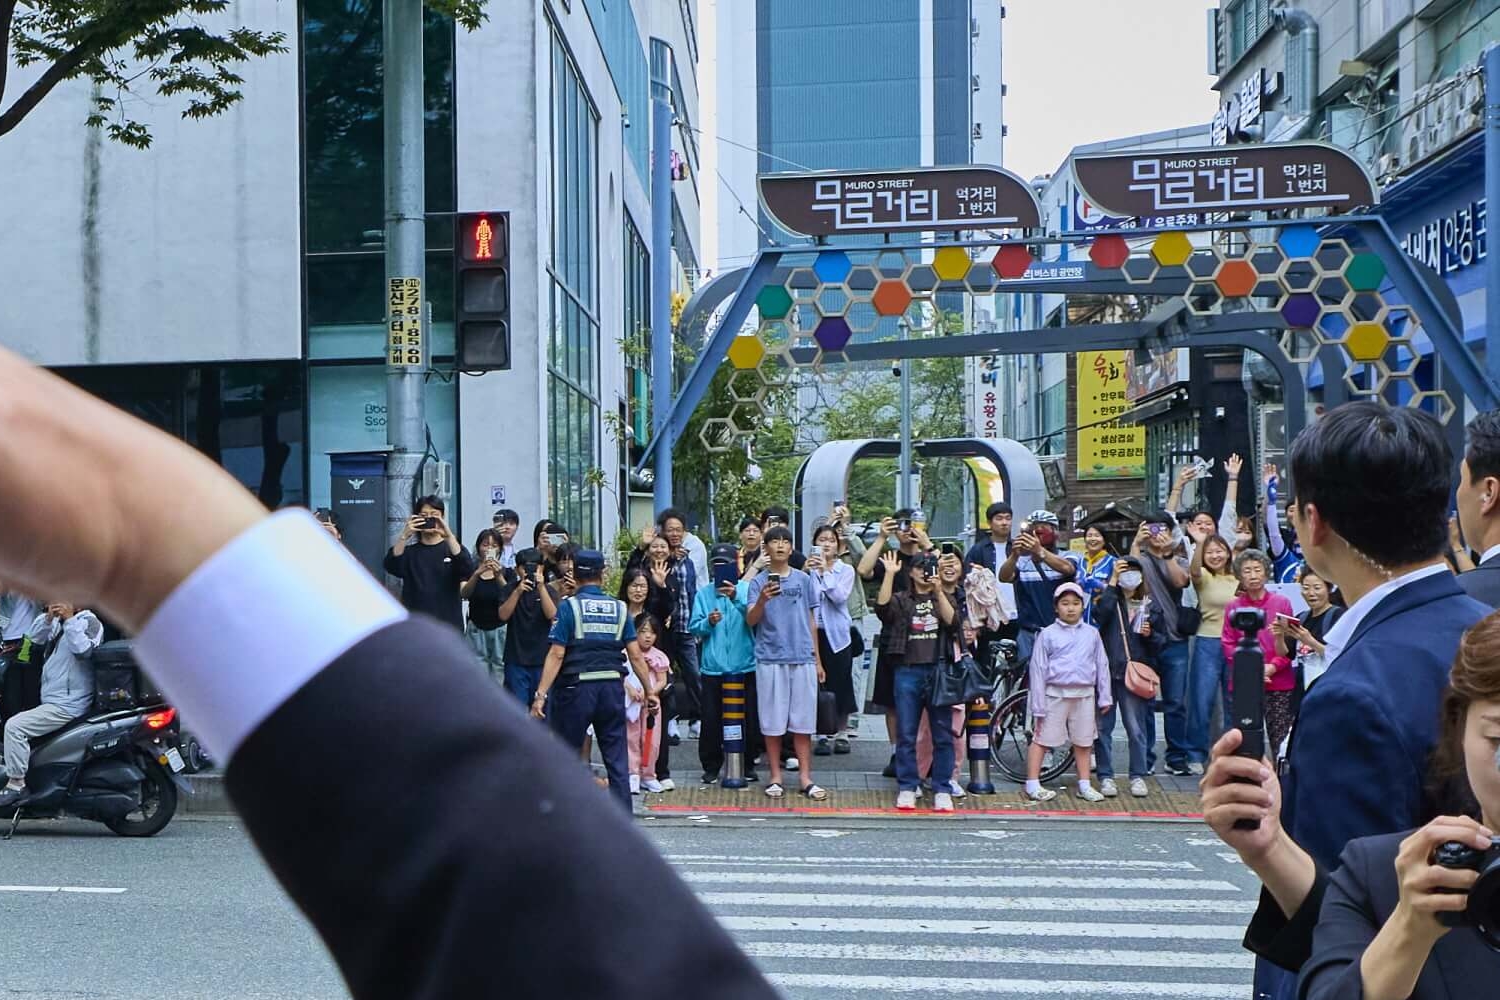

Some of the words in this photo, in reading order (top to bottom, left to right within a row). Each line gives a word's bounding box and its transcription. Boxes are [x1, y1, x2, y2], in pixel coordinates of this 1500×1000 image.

[1165, 160, 1195, 169] MURO
[1198, 157, 1239, 167] STREET
[1283, 162, 1327, 178] 먹거리
[845, 181, 875, 190] MURO
[877, 178, 915, 189] STREET
[956, 186, 997, 201] 먹거리
[1100, 448, 1146, 458] 한우곱창전
